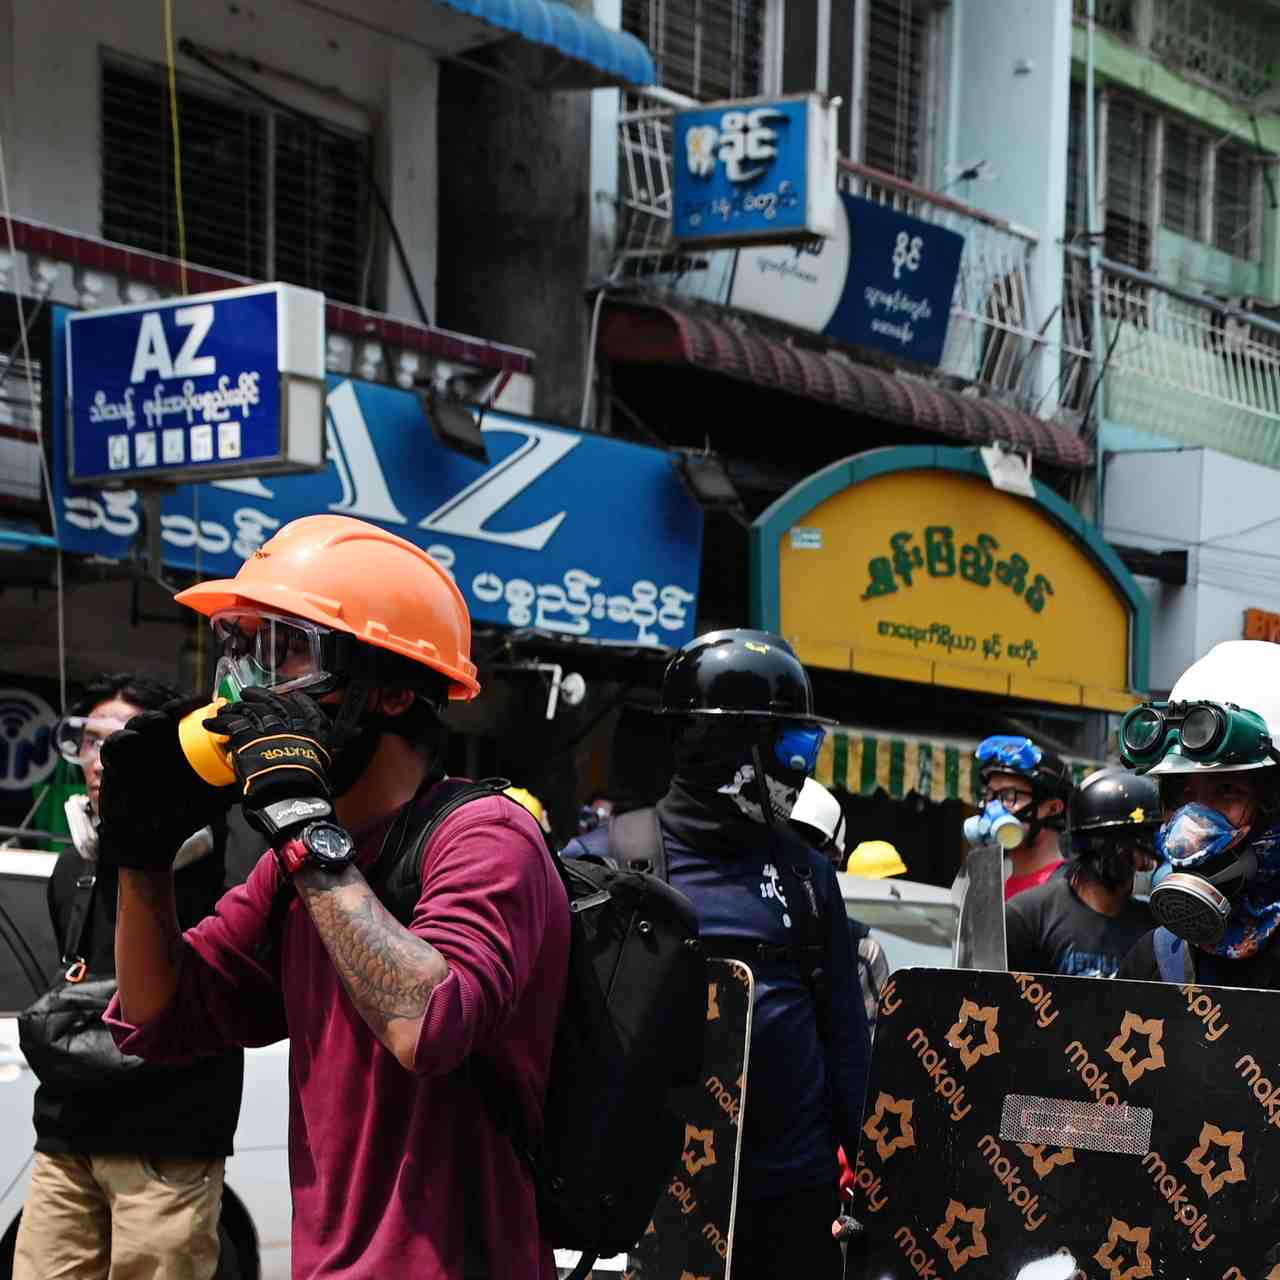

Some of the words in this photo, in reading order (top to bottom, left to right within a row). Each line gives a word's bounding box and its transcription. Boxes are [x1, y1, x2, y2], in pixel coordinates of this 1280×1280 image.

[130, 304, 216, 384] AZ
[1012, 973, 1060, 1029] kply
[1182, 985, 1230, 1042] kply
[907, 1027, 973, 1121] makply
[1064, 1040, 1130, 1120] makp
[856, 1150, 889, 1212] ply
[977, 1134, 1048, 1232] makply
[1142, 1151, 1217, 1251] makply
